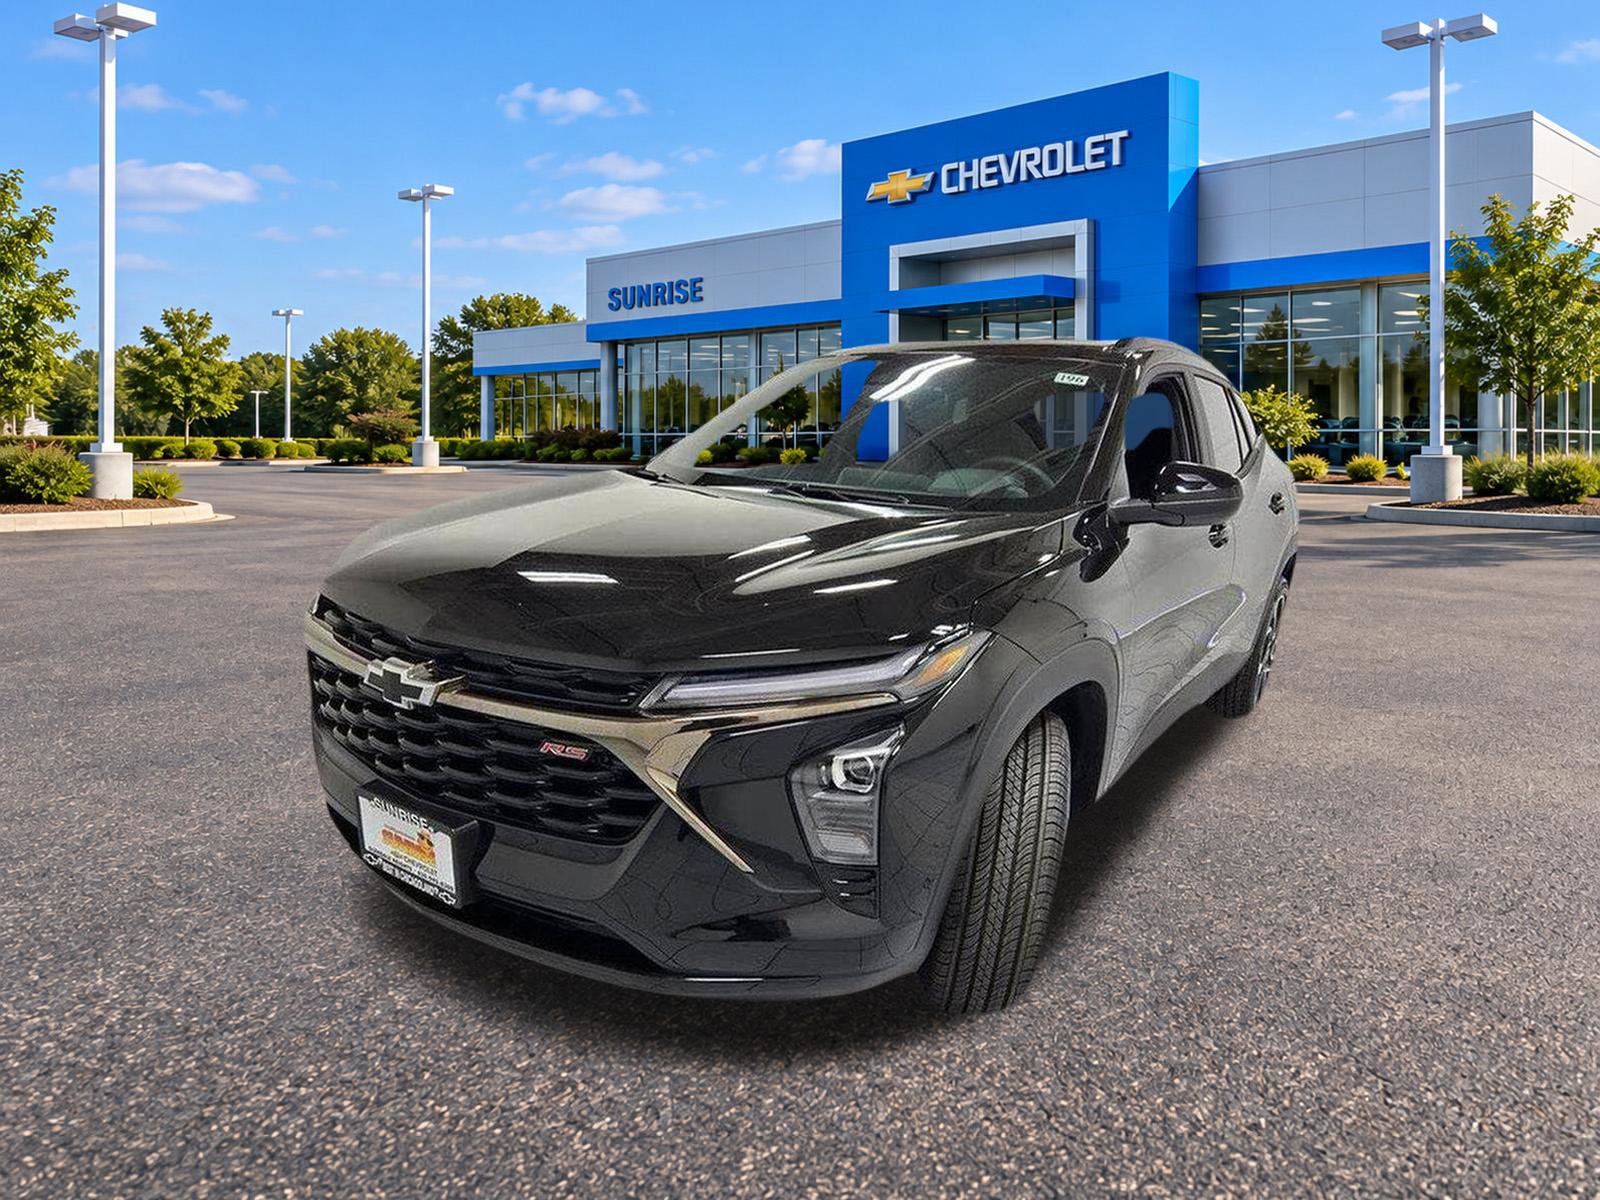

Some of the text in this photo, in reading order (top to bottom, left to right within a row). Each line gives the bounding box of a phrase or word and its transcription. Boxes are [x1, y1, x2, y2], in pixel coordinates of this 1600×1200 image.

[940, 130, 1128, 194] CHEVROLET
[607, 277, 704, 311] SUNRISE
[540, 742, 588, 760] RS
[373, 797, 430, 831] SUNRISE
